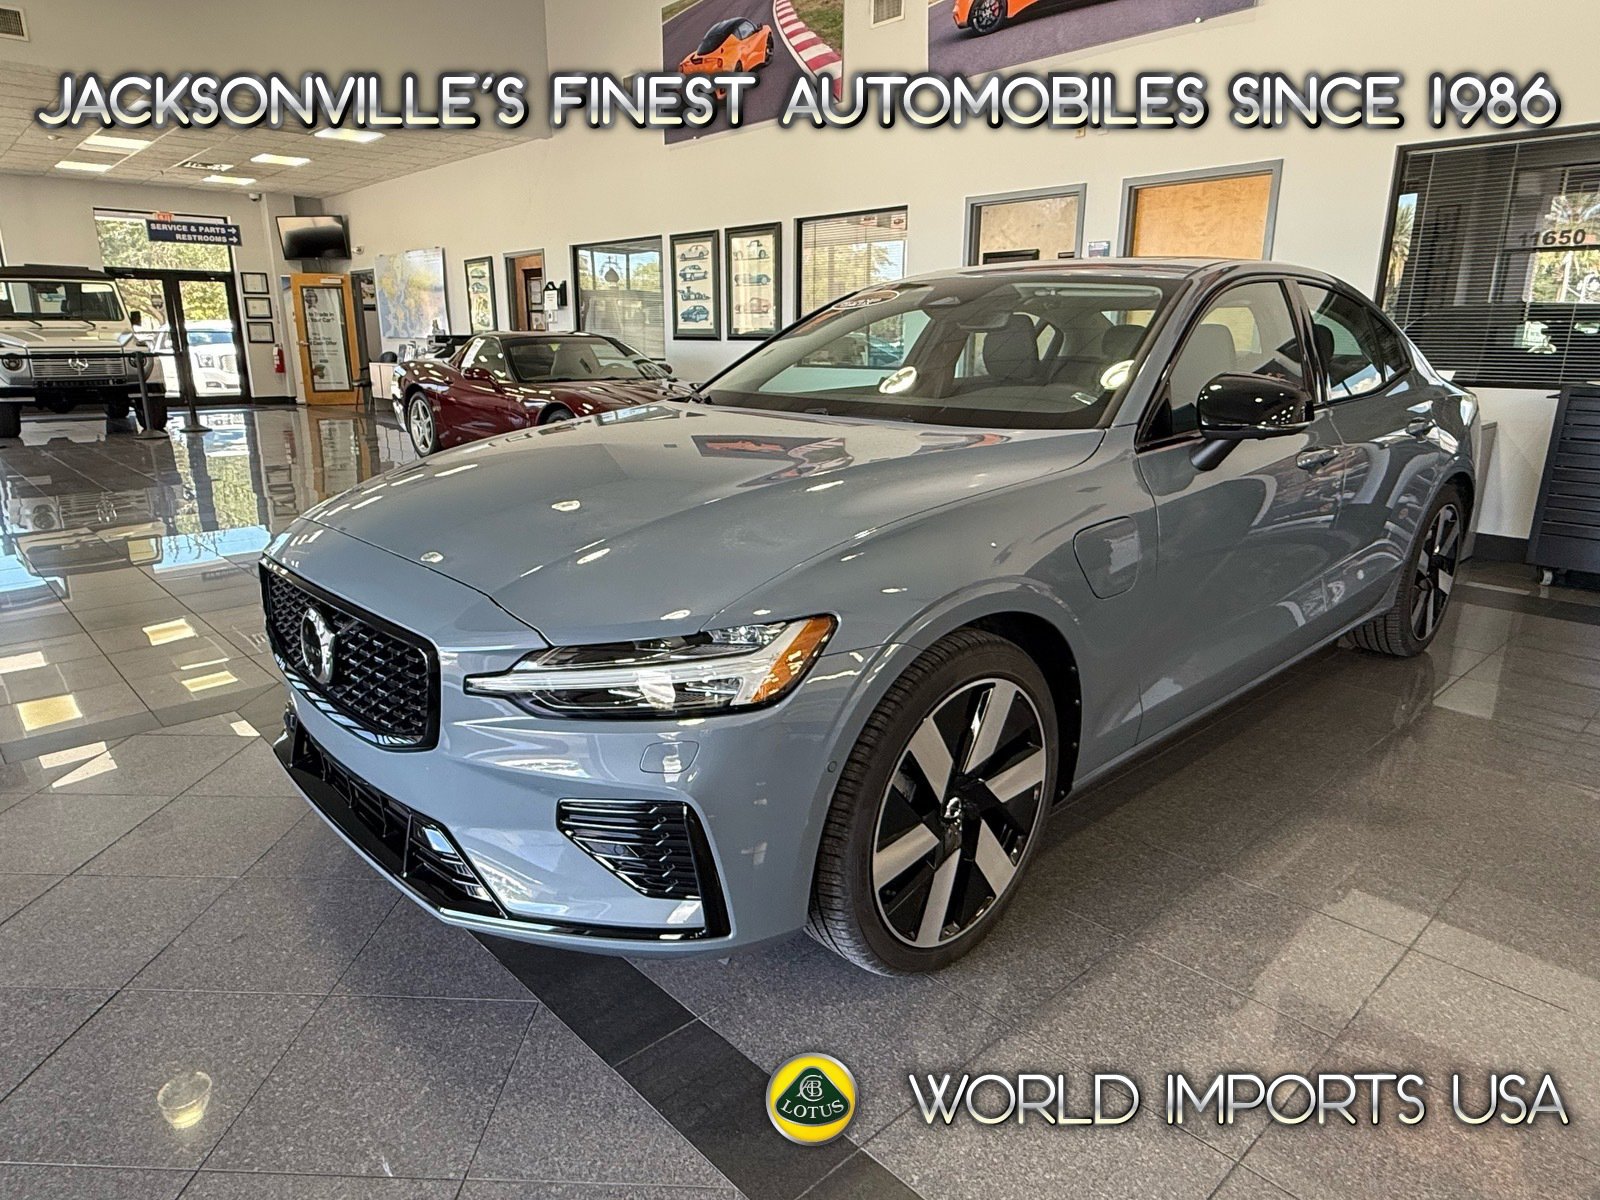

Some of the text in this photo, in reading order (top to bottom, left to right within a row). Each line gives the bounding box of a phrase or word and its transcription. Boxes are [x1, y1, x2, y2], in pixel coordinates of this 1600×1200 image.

[150, 223, 188, 232] SERVICE
[199, 226, 226, 234] PARTS
[175, 233, 227, 243] RESTROOMS
[1519, 228, 1586, 246] 11650
